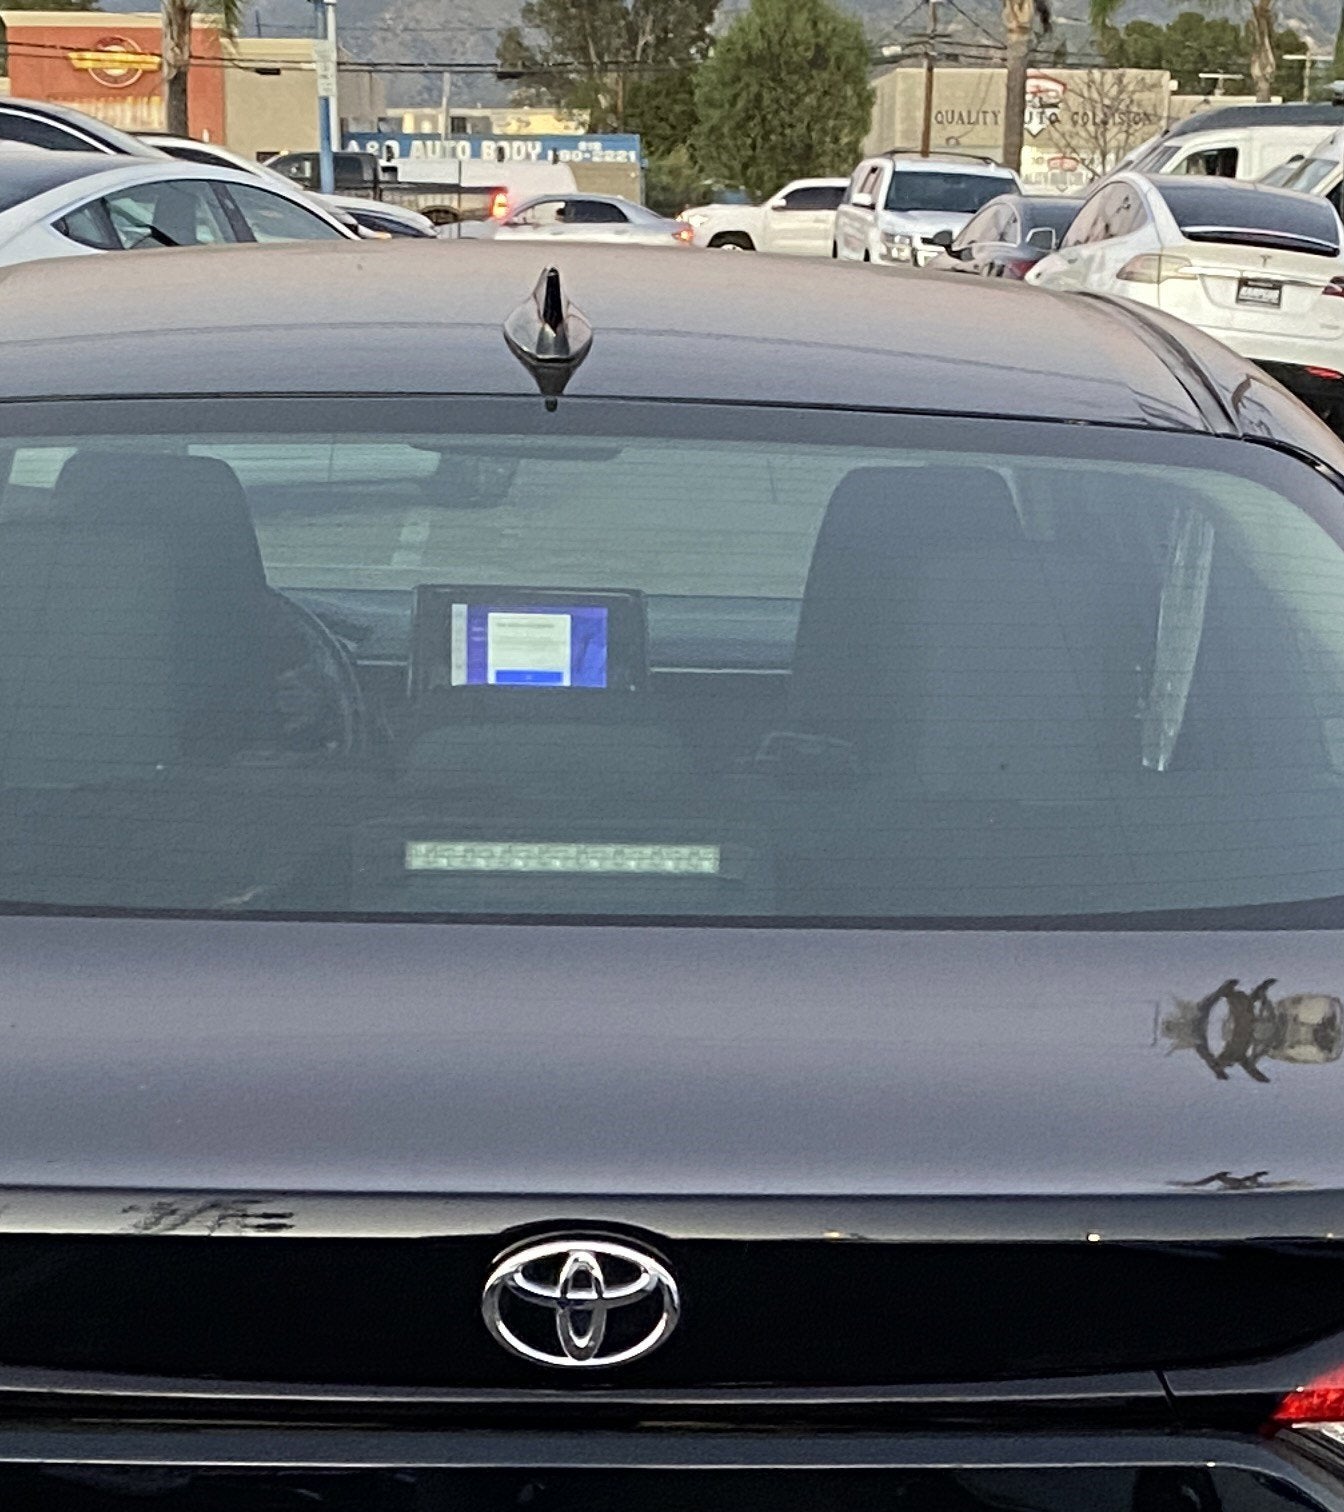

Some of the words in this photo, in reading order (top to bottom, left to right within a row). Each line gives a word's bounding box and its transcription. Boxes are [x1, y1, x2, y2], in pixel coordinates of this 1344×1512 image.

[935, 110, 1001, 125] QUALITY
[1023, 111, 1060, 125] UTO
[408, 140, 471, 160] AUTO
[481, 140, 542, 161] BODY
